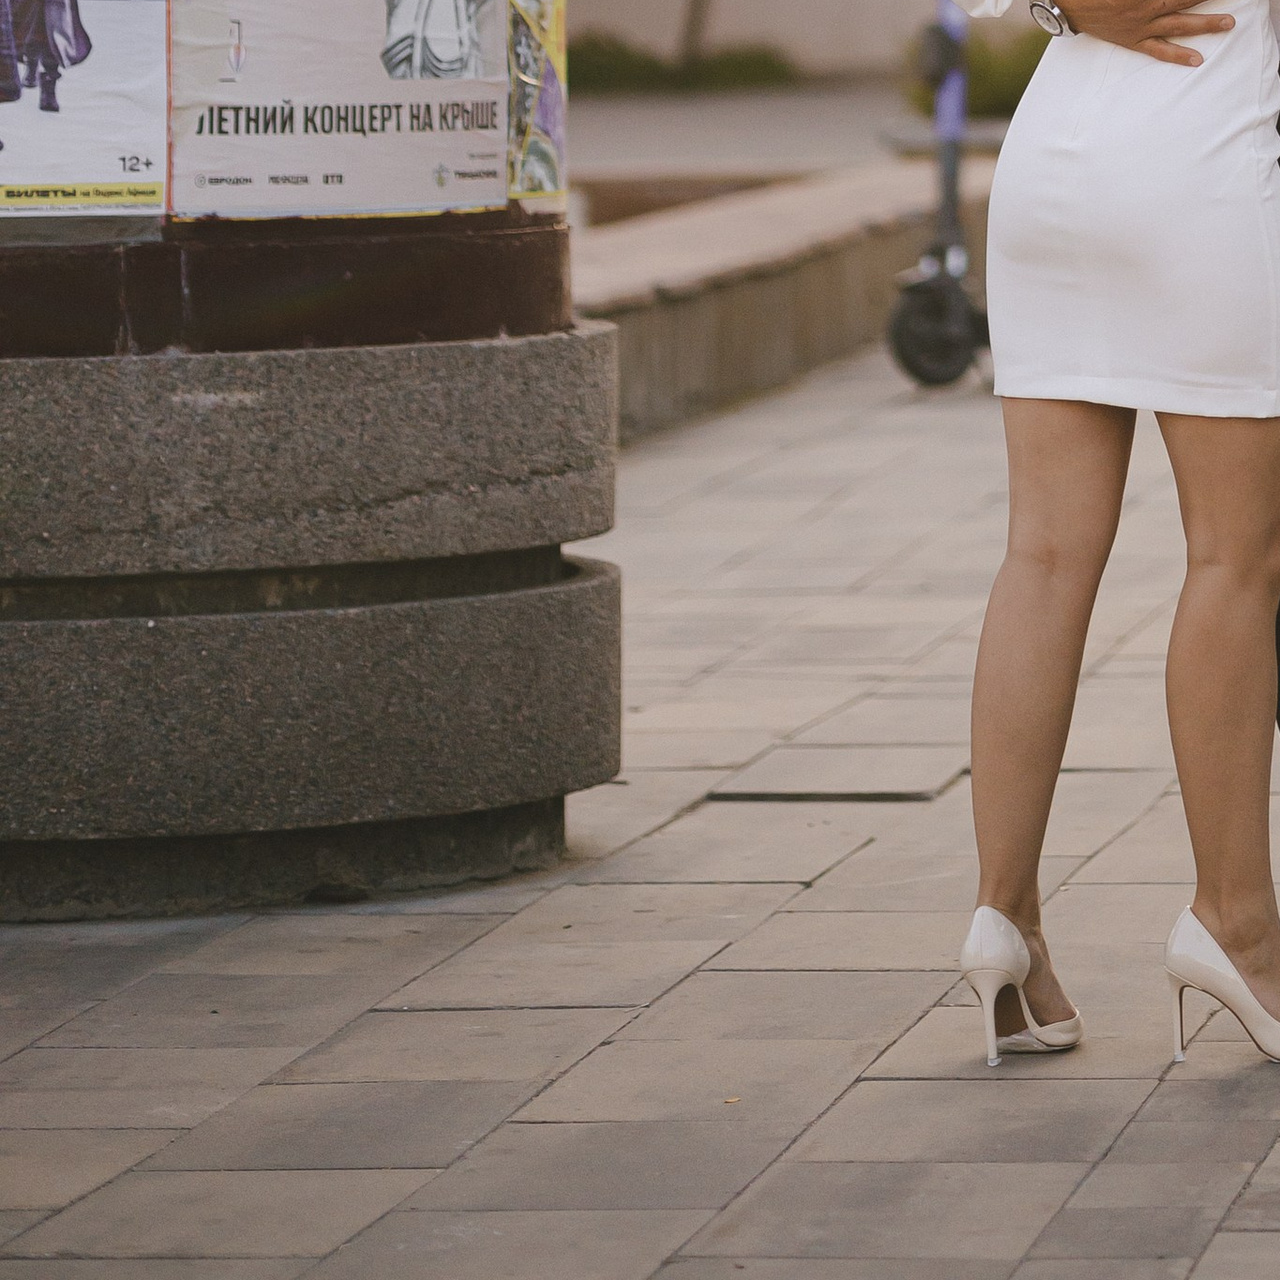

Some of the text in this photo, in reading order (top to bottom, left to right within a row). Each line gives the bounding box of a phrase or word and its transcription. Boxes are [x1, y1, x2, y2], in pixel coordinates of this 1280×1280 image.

[303, 103, 403, 137] КОНЦЕРТ
[408, 102, 434, 132] НА
[438, 101, 498, 131] КРЫШЕ
[119, 156, 153, 172] 12+
[5, 188, 77, 199] БИЛЕТЫ
